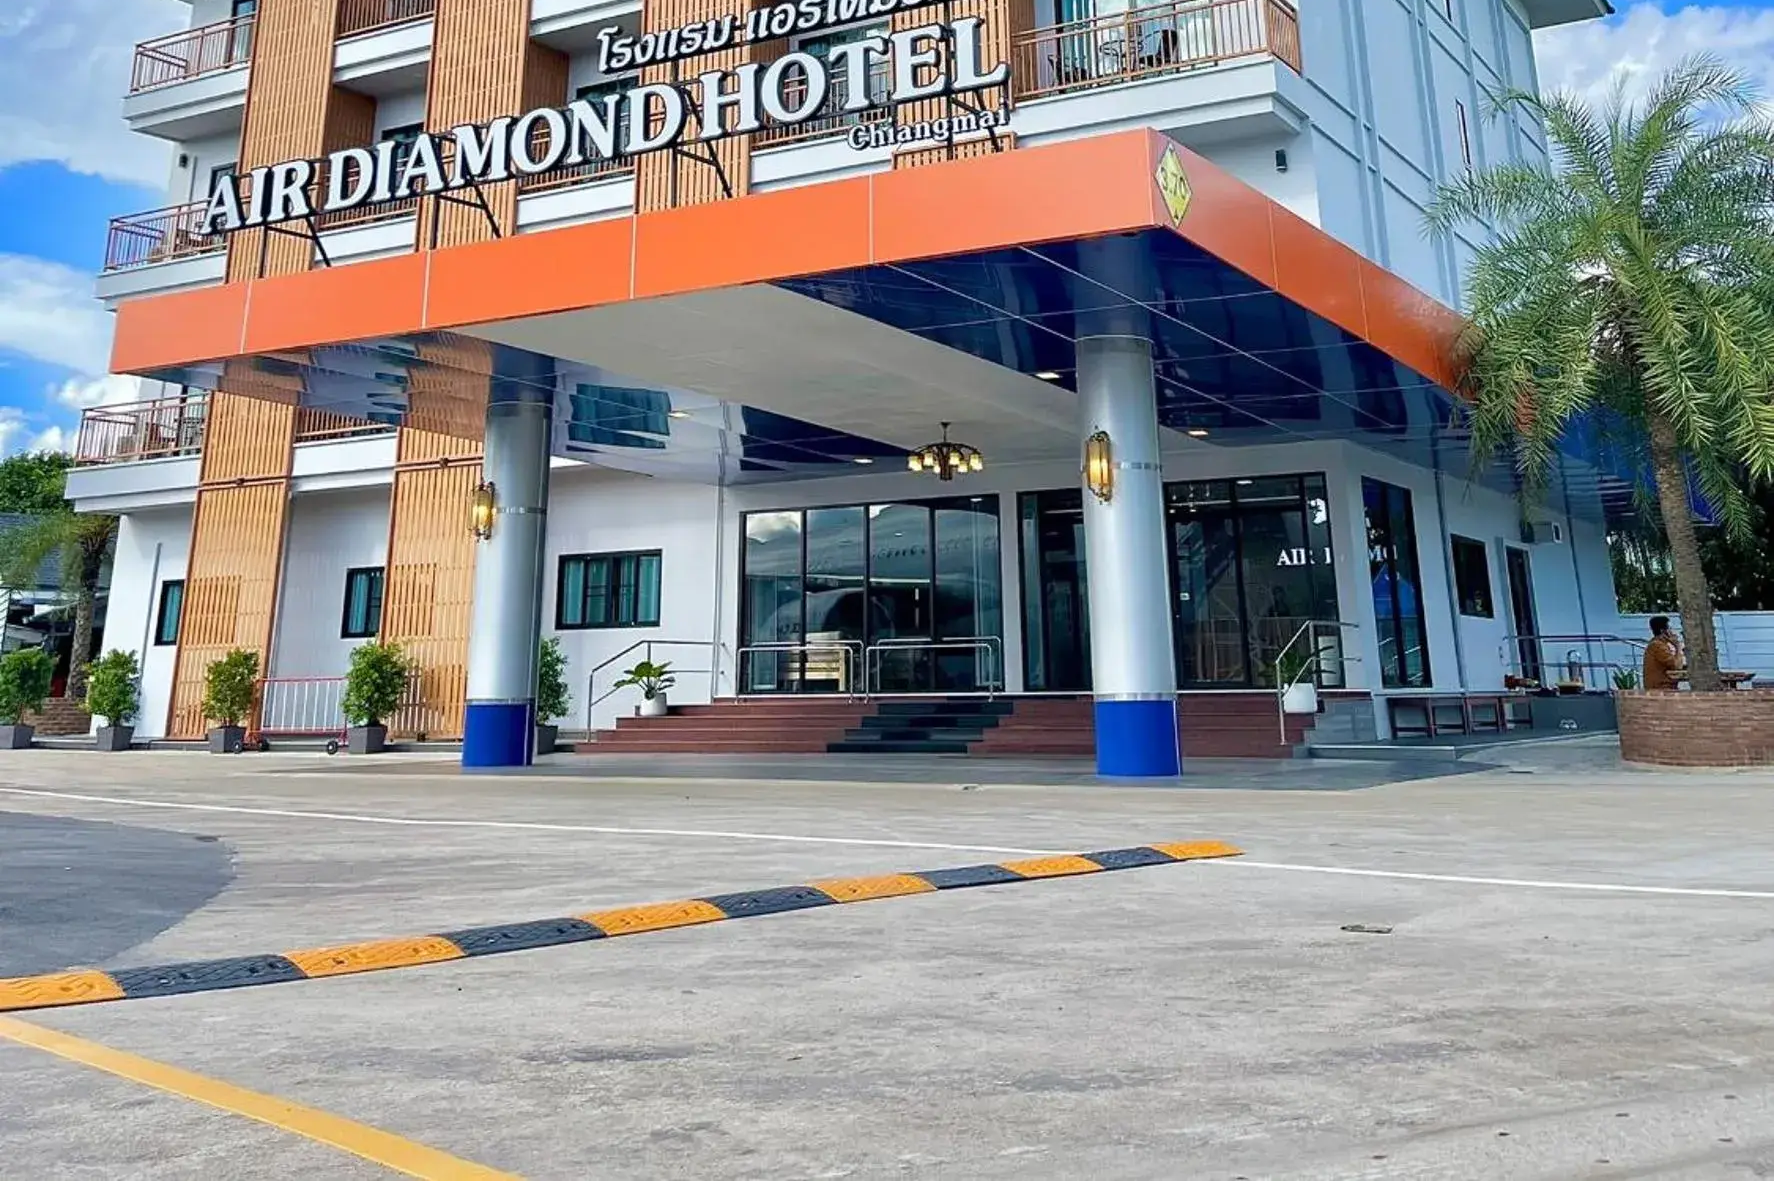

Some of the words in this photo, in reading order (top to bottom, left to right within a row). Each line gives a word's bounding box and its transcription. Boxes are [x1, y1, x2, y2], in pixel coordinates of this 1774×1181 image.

[597, 15, 734, 73] โรงแรม
[201, 160, 312, 234] AIR
[323, 83, 685, 211] DIAMOND
[699, 17, 1009, 139] HOTEL
[849, 98, 1009, 149] Chiangmai
